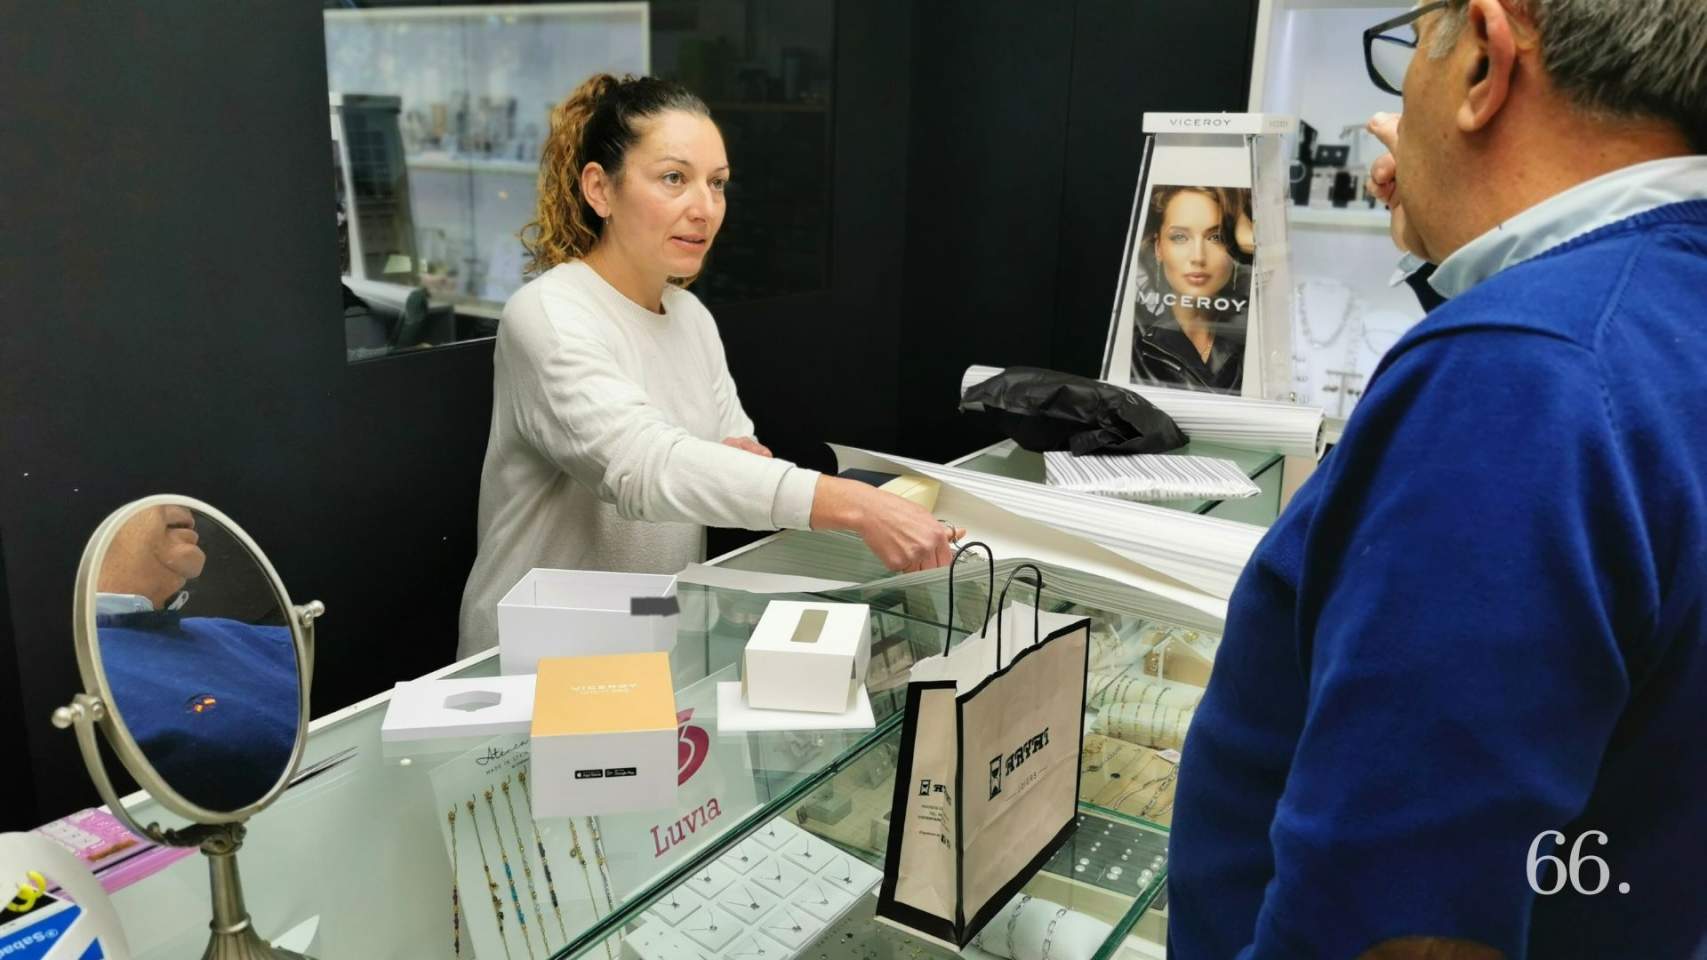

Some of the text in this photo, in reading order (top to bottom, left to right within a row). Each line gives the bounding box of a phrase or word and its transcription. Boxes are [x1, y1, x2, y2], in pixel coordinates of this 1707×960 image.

[1169, 118, 1232, 127] VICEROY
[1139, 291, 1247, 312] VICEROY
[650, 797, 722, 858] Luvia
